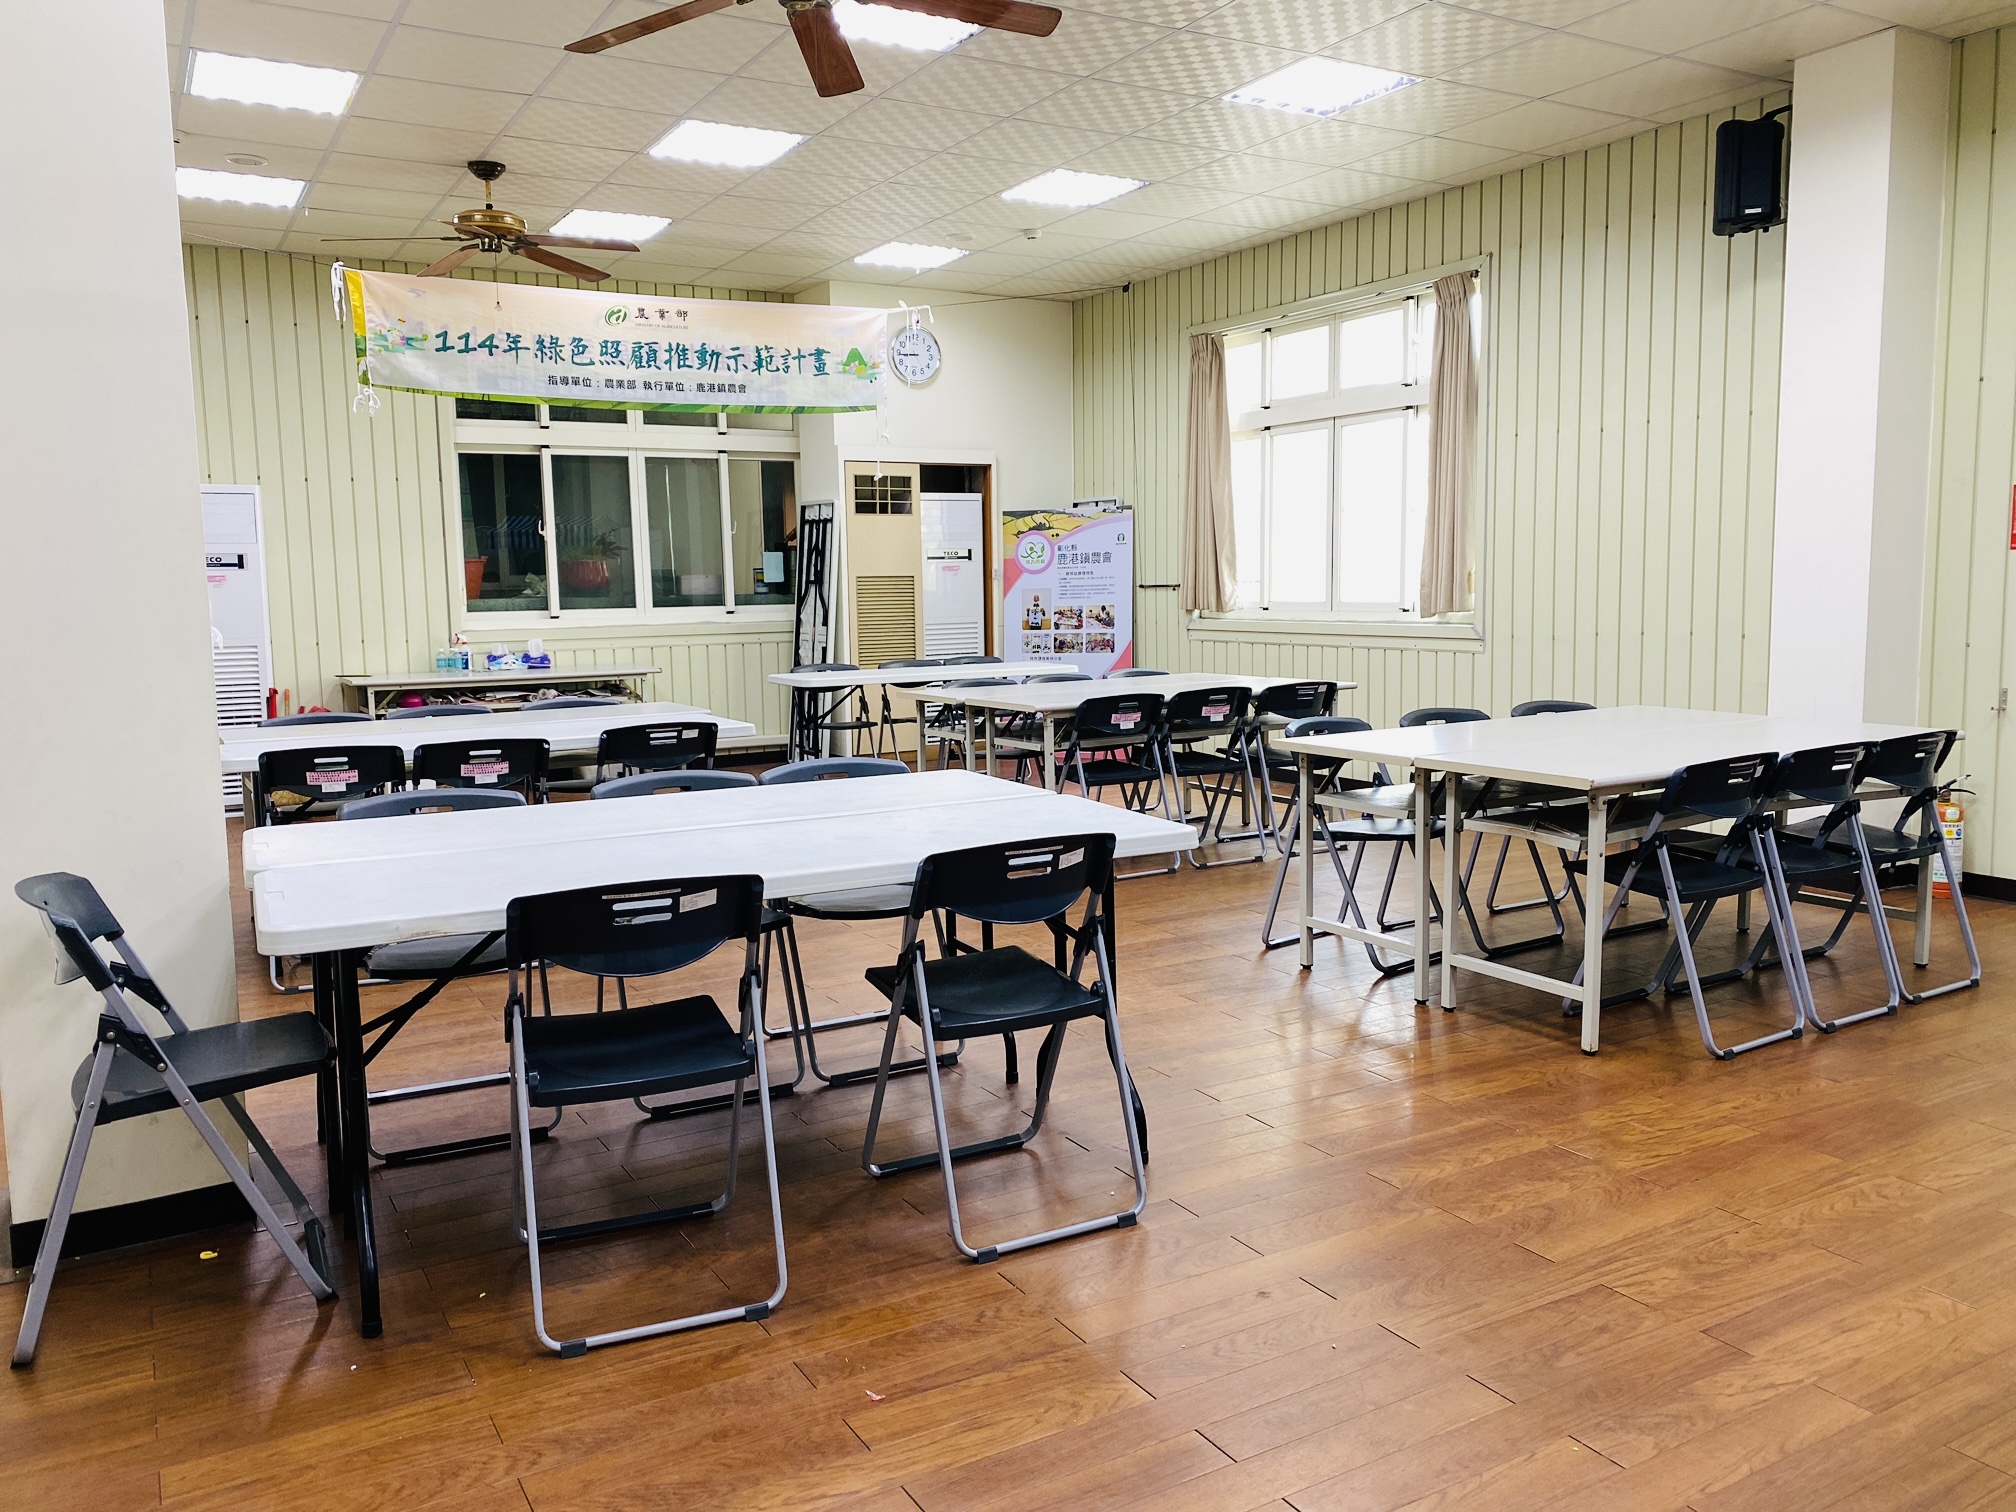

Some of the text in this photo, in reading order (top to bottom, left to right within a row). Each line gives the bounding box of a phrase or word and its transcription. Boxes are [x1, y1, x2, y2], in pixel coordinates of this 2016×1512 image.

[434, 330, 831, 377] 114年綠色照顧推動示範計畫
[1058, 551, 1112, 565] 鹿港鎮農會
